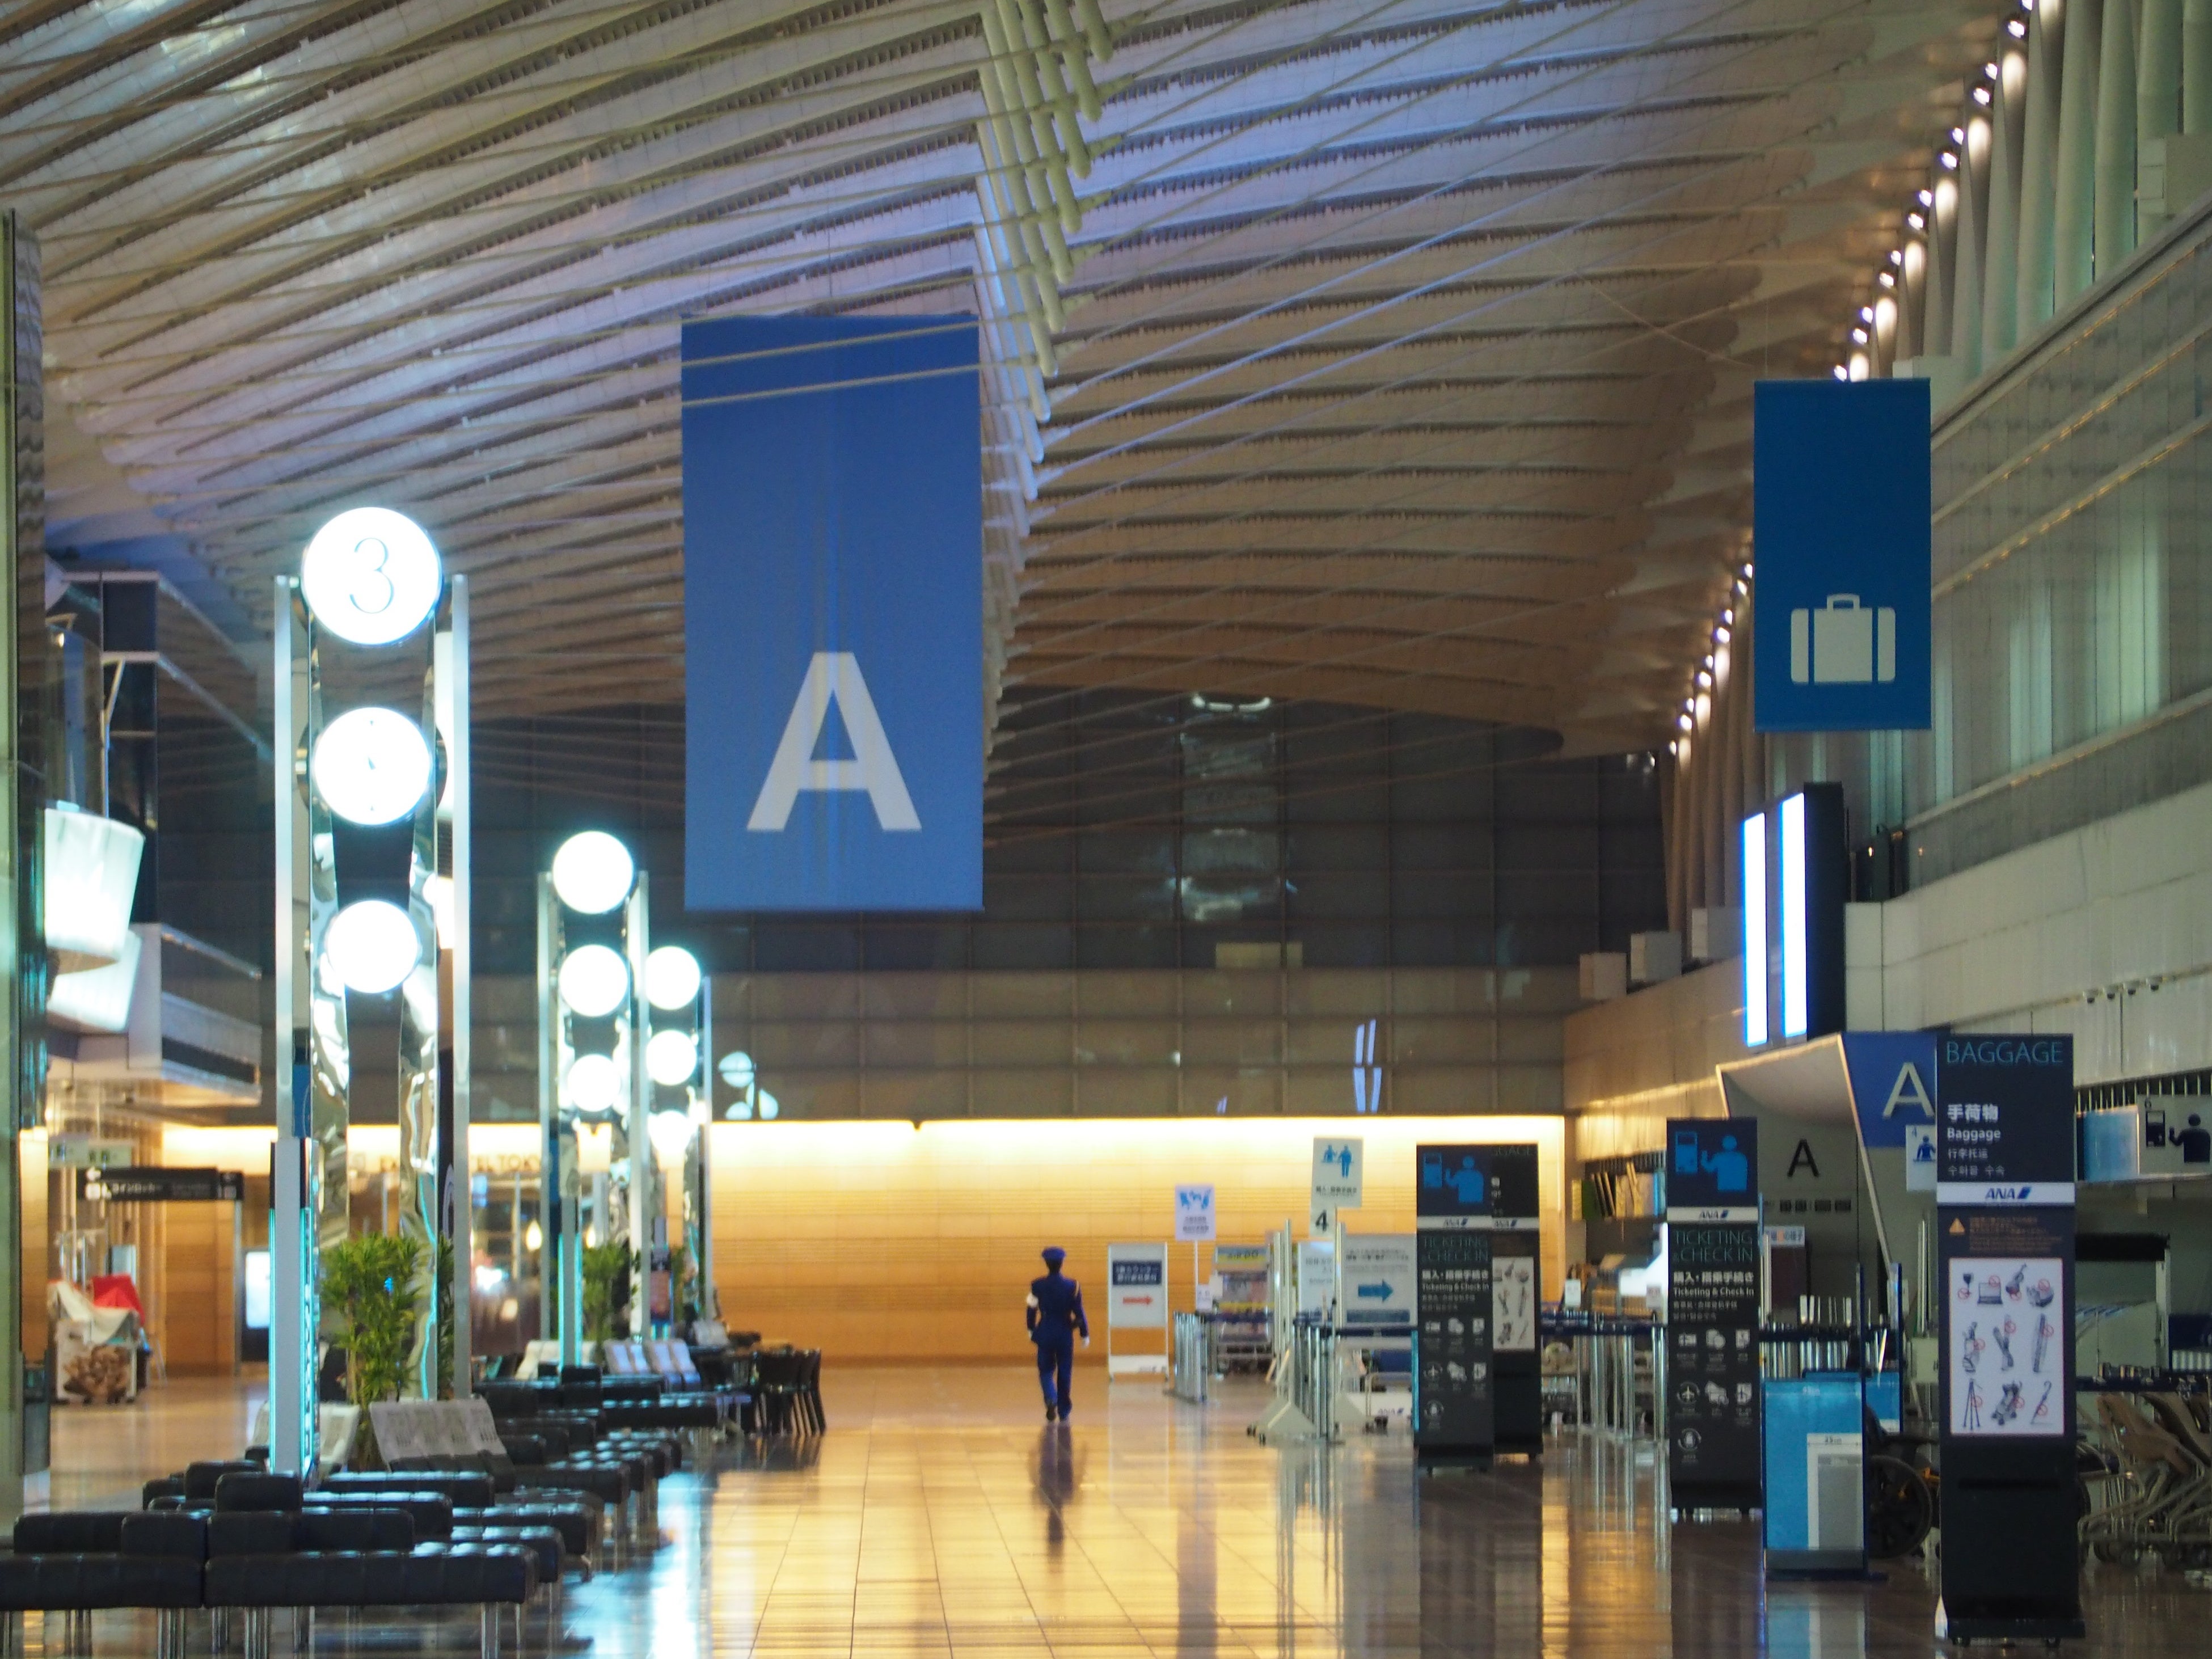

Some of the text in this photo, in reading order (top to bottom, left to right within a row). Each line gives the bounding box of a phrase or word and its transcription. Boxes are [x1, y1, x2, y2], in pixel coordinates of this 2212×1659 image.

[349, 537, 394, 614] 3
[746, 652, 922, 831] A
[1946, 1041, 2064, 1064] BAGGAGE
[1882, 1062, 1935, 1118] A
[1947, 1103, 1999, 1122] 手荷物
[1947, 1127, 2002, 1144] Baggage
[1787, 1139, 1820, 1177] A
[1986, 1188, 2015, 1200] ANA
[1315, 1209, 1328, 1232] 4
[1674, 1230, 1753, 1245] TICKETING
[1738, 1248, 1753, 1263] IN
[1674, 1287, 1711, 1298] Ticketing
[1720, 1287, 1744, 1297] Check
[1746, 1287, 1755, 1297] In
